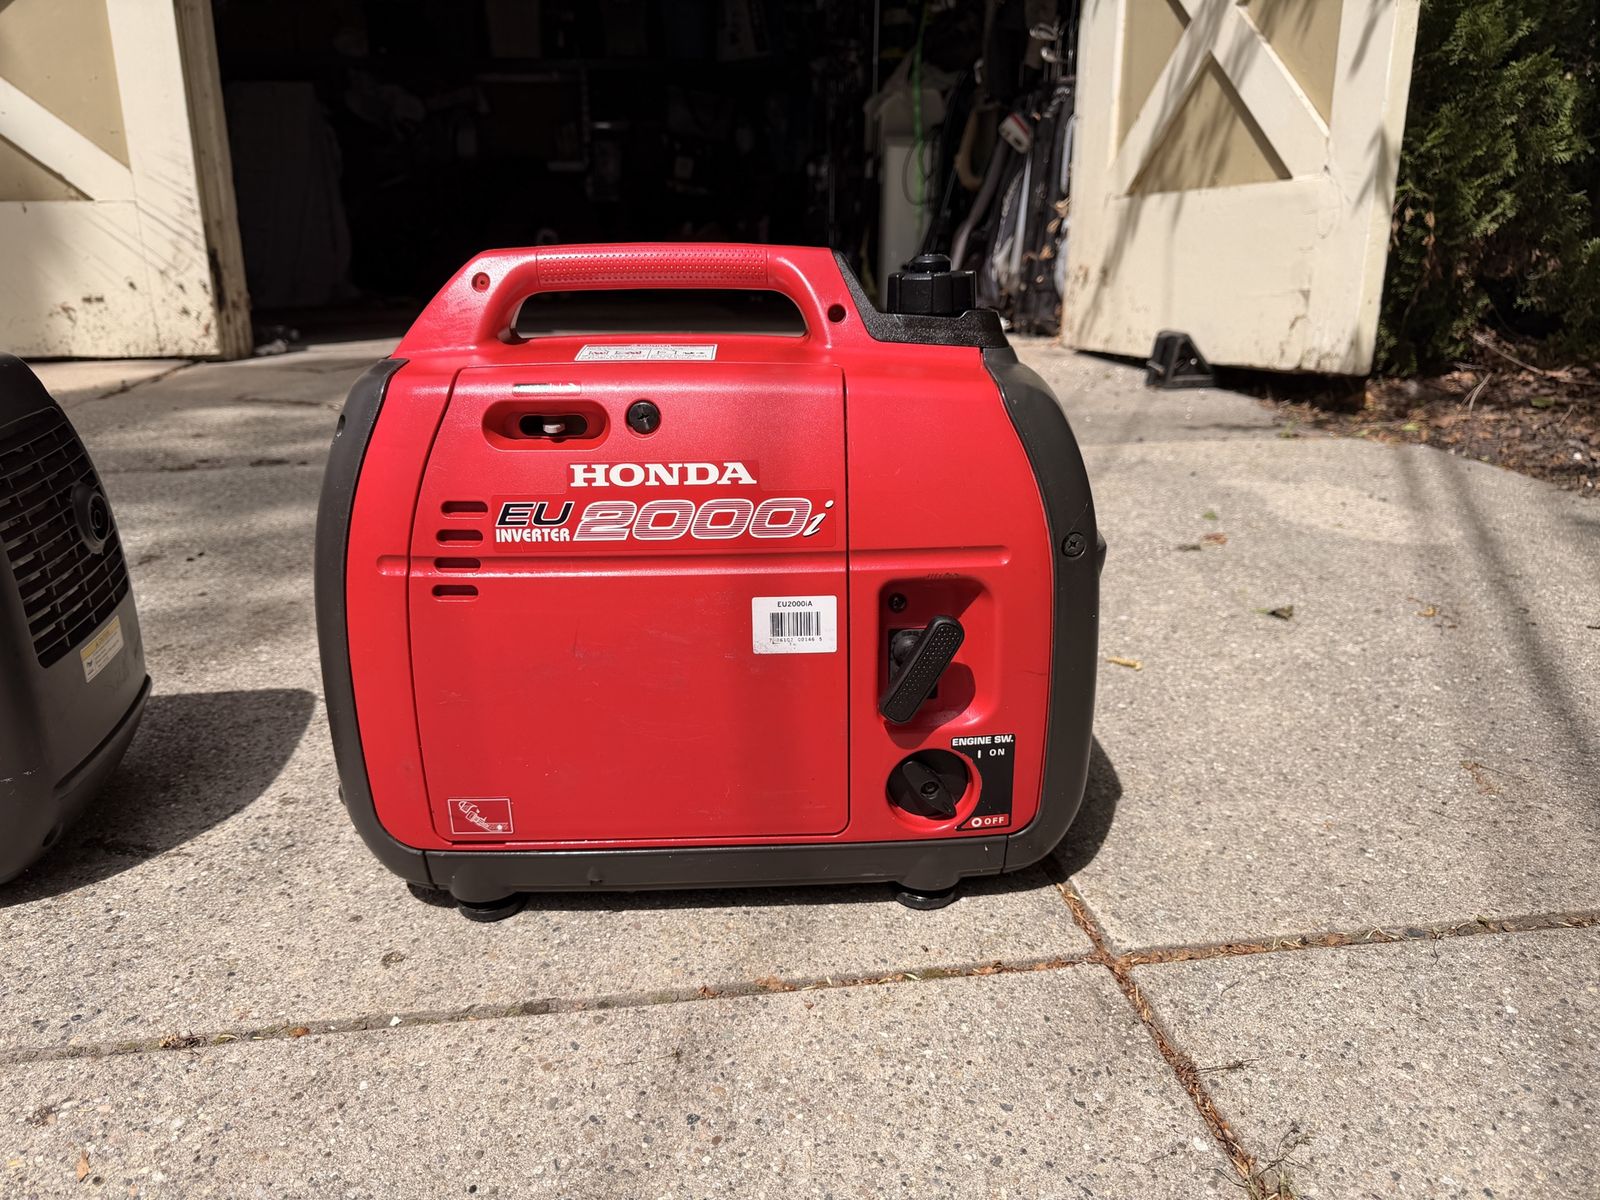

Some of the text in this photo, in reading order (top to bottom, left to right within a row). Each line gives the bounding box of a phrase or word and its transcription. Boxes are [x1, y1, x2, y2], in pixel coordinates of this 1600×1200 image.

[569, 462, 757, 488] HONDA
[494, 497, 834, 541] EU 2000i
[495, 528, 570, 543] INVERTER
[952, 734, 1014, 746] ENGINE SW.
[989, 748, 1005, 756] ON
[984, 816, 1005, 825] OFF
